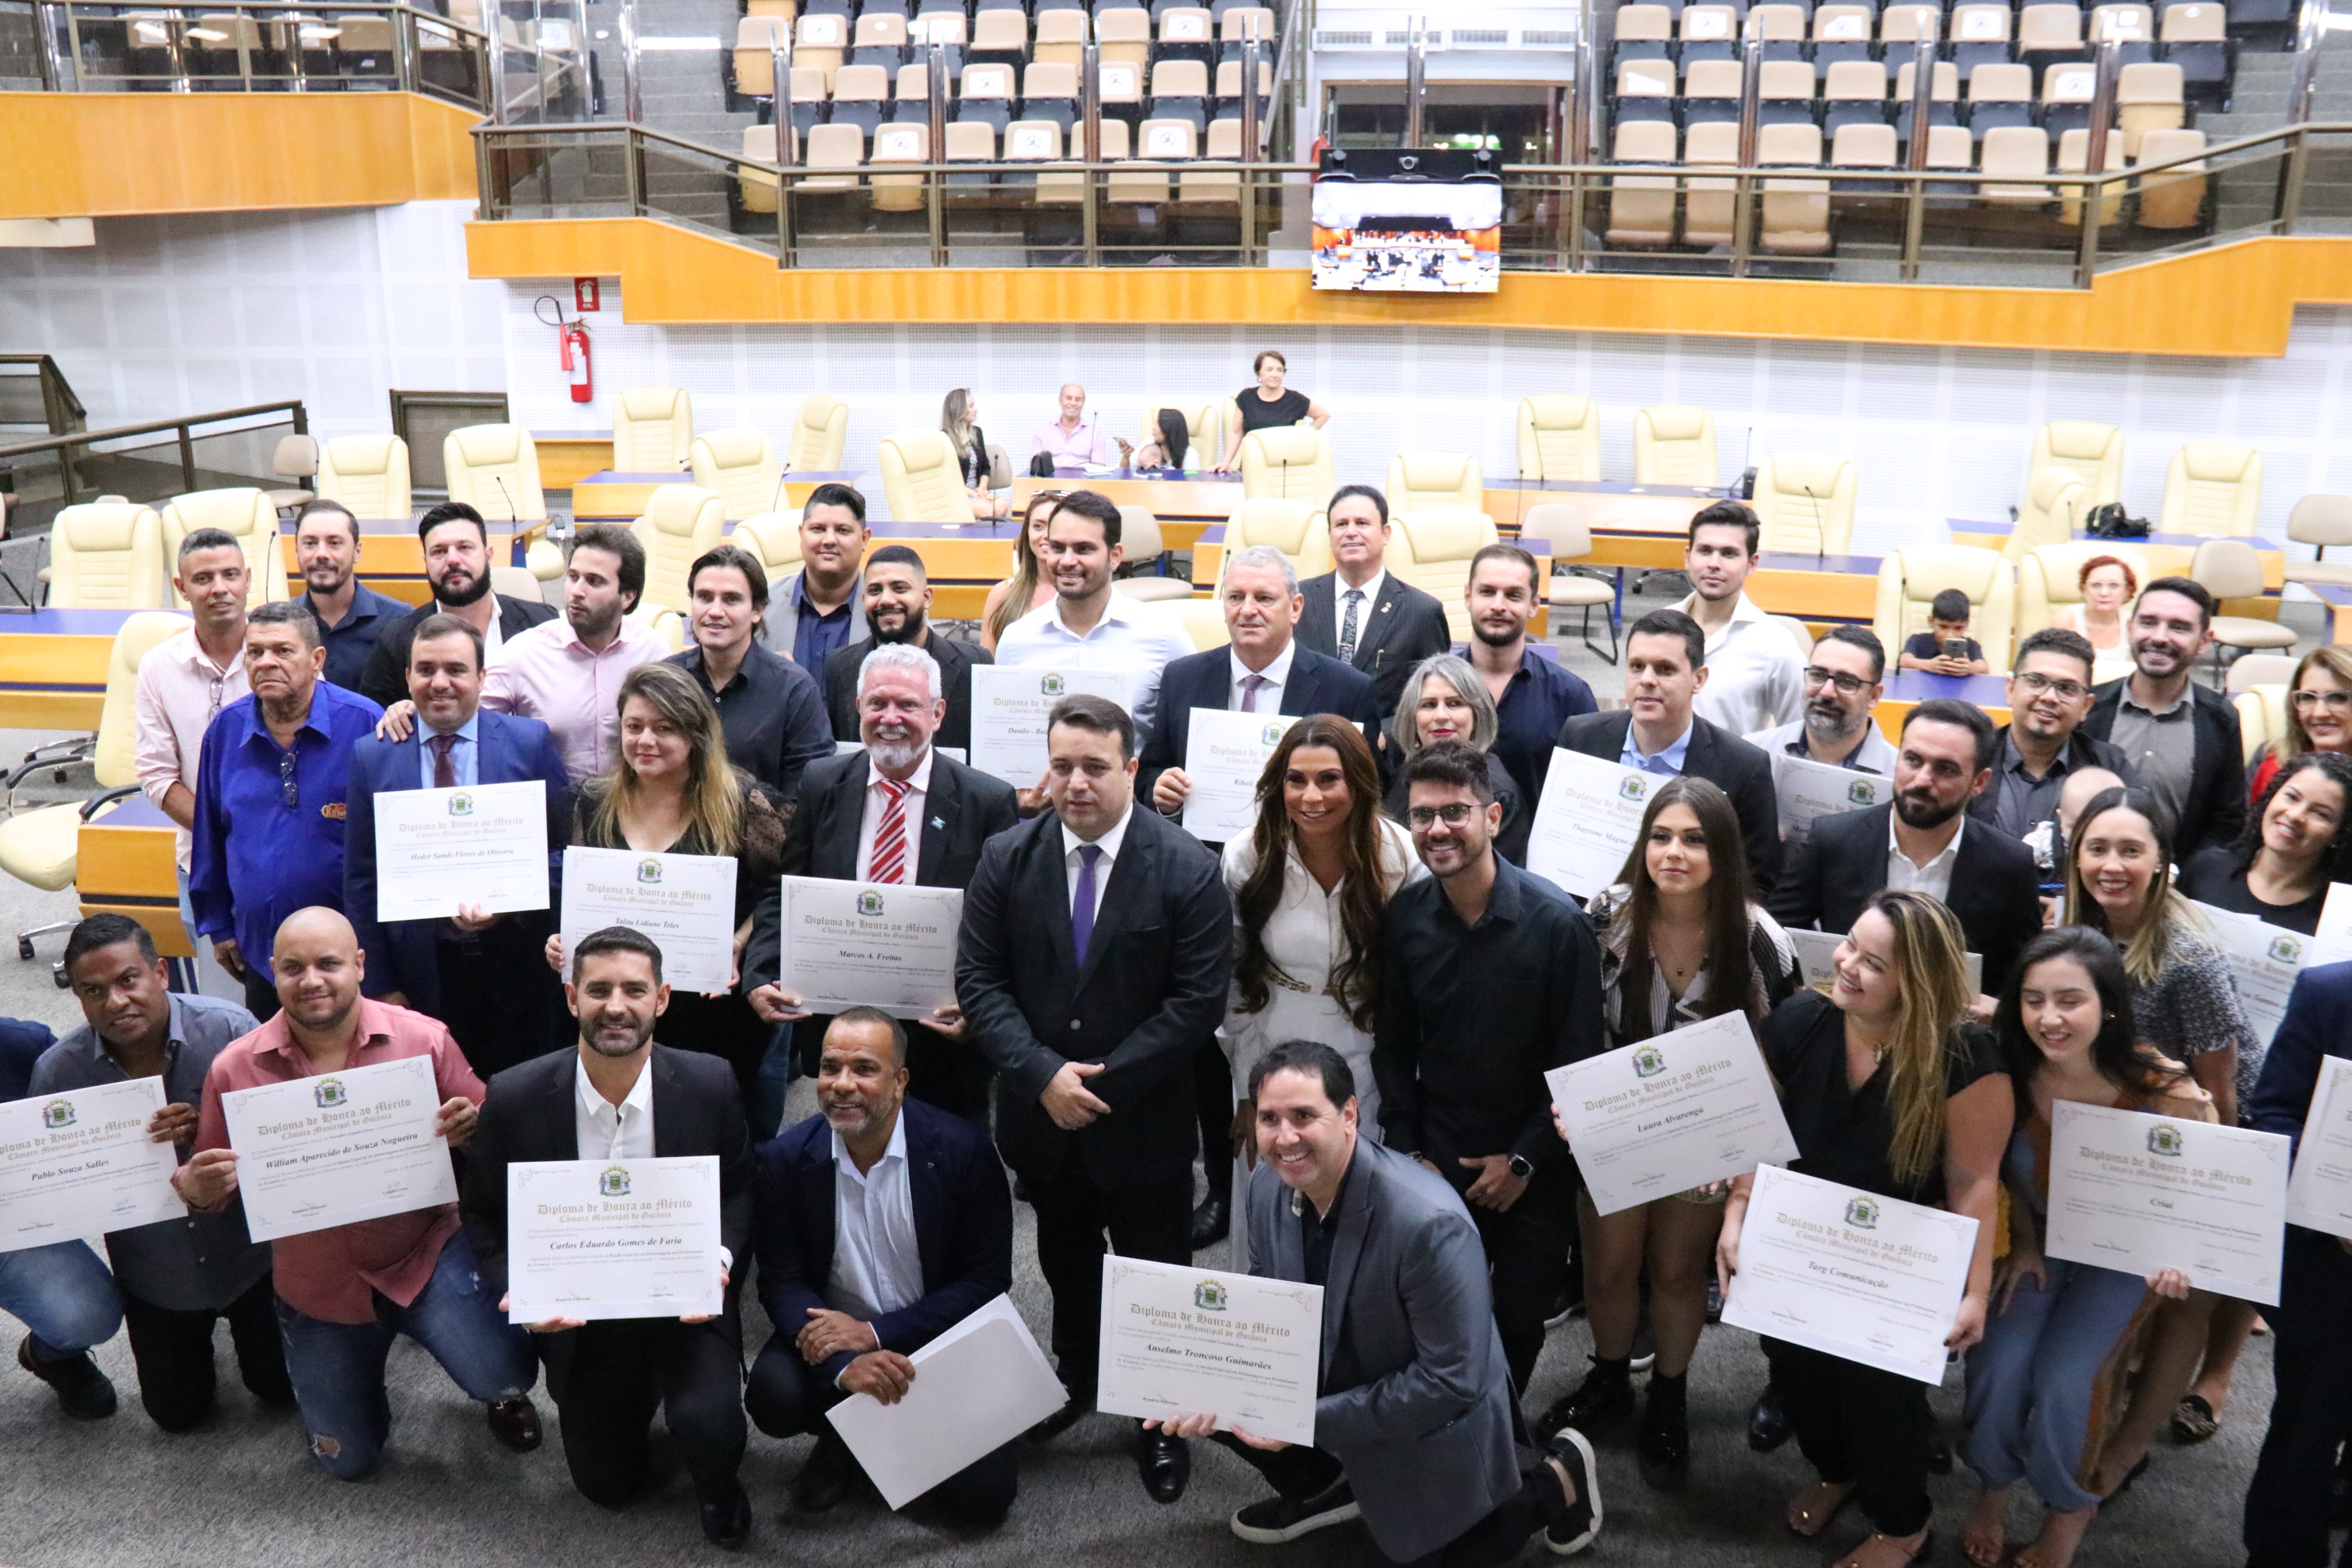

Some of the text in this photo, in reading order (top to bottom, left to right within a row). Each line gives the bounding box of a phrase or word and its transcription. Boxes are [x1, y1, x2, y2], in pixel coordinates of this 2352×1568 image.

[993, 697, 1028, 707] Diploma
[1210, 744, 1246, 756] Diploma
[1566, 787, 1602, 805] Diploma
[1604, 798, 1614, 808] de
[398, 823, 435, 832] Diploma
[493, 817, 523, 827] Mérito
[586, 883, 623, 894] Diploma
[638, 887, 665, 897] Honra
[680, 890, 711, 900] Mérito
[628, 896, 659, 905] Municipal
[804, 914, 842, 926] Diploma
[846, 918, 855, 927] de
[858, 919, 888, 929] Honra
[905, 923, 937, 933] Mérito
[849, 929, 882, 937] Municipal
[1582, 1060, 1732, 1111] Diploma de Honra ao Mérito
[257, 1121, 303, 1136] Diploma
[321, 1110, 356, 1123] Honra
[375, 1099, 411, 1114] Mérito
[281, 1129, 311, 1140] Câmara
[313, 1121, 350, 1135] Municipal
[362, 1114, 392, 1124] Goiânia
[1637, 1121, 1662, 1132] Laura
[1664, 1107, 1704, 1123] Alvarenga
[0, 1141, 32, 1154] ploma
[49, 1130, 85, 1144] Honra
[104, 1119, 141, 1133] Mérito
[7, 1150, 38, 1160] Câmara
[40, 1140, 79, 1155] Municipal
[91, 1133, 122, 1143] Goiânia
[266, 1158, 297, 1168] William
[300, 1148, 341, 1163] Aparecido
[353, 1141, 379, 1151] Souza
[381, 1133, 417, 1145] Nogueira
[31, 1159, 109, 1181] Pablo Souza Salles
[537, 1204, 583, 1215] Diploma
[587, 1203, 598, 1212] de
[602, 1201, 636, 1212] Honra
[655, 1198, 692, 1210] Mérito
[591, 1212, 629, 1222] Municipal
[579, 1239, 615, 1248] Eduardo
[659, 1236, 682, 1245] Faria
[1777, 1212, 1938, 1263] Diploma de Honra ao Mérito
[1829, 1267, 1889, 1288] Comunicação
[1130, 1303, 1290, 1336] Diploma de Honra ao Mérito
[1151, 1318, 1182, 1329] Câmara
[1184, 1323, 1223, 1336] Municipal
[1235, 1331, 1267, 1343] Goiânia
[1144, 1344, 1271, 1370] Anselmo Troncoso Guimarães
